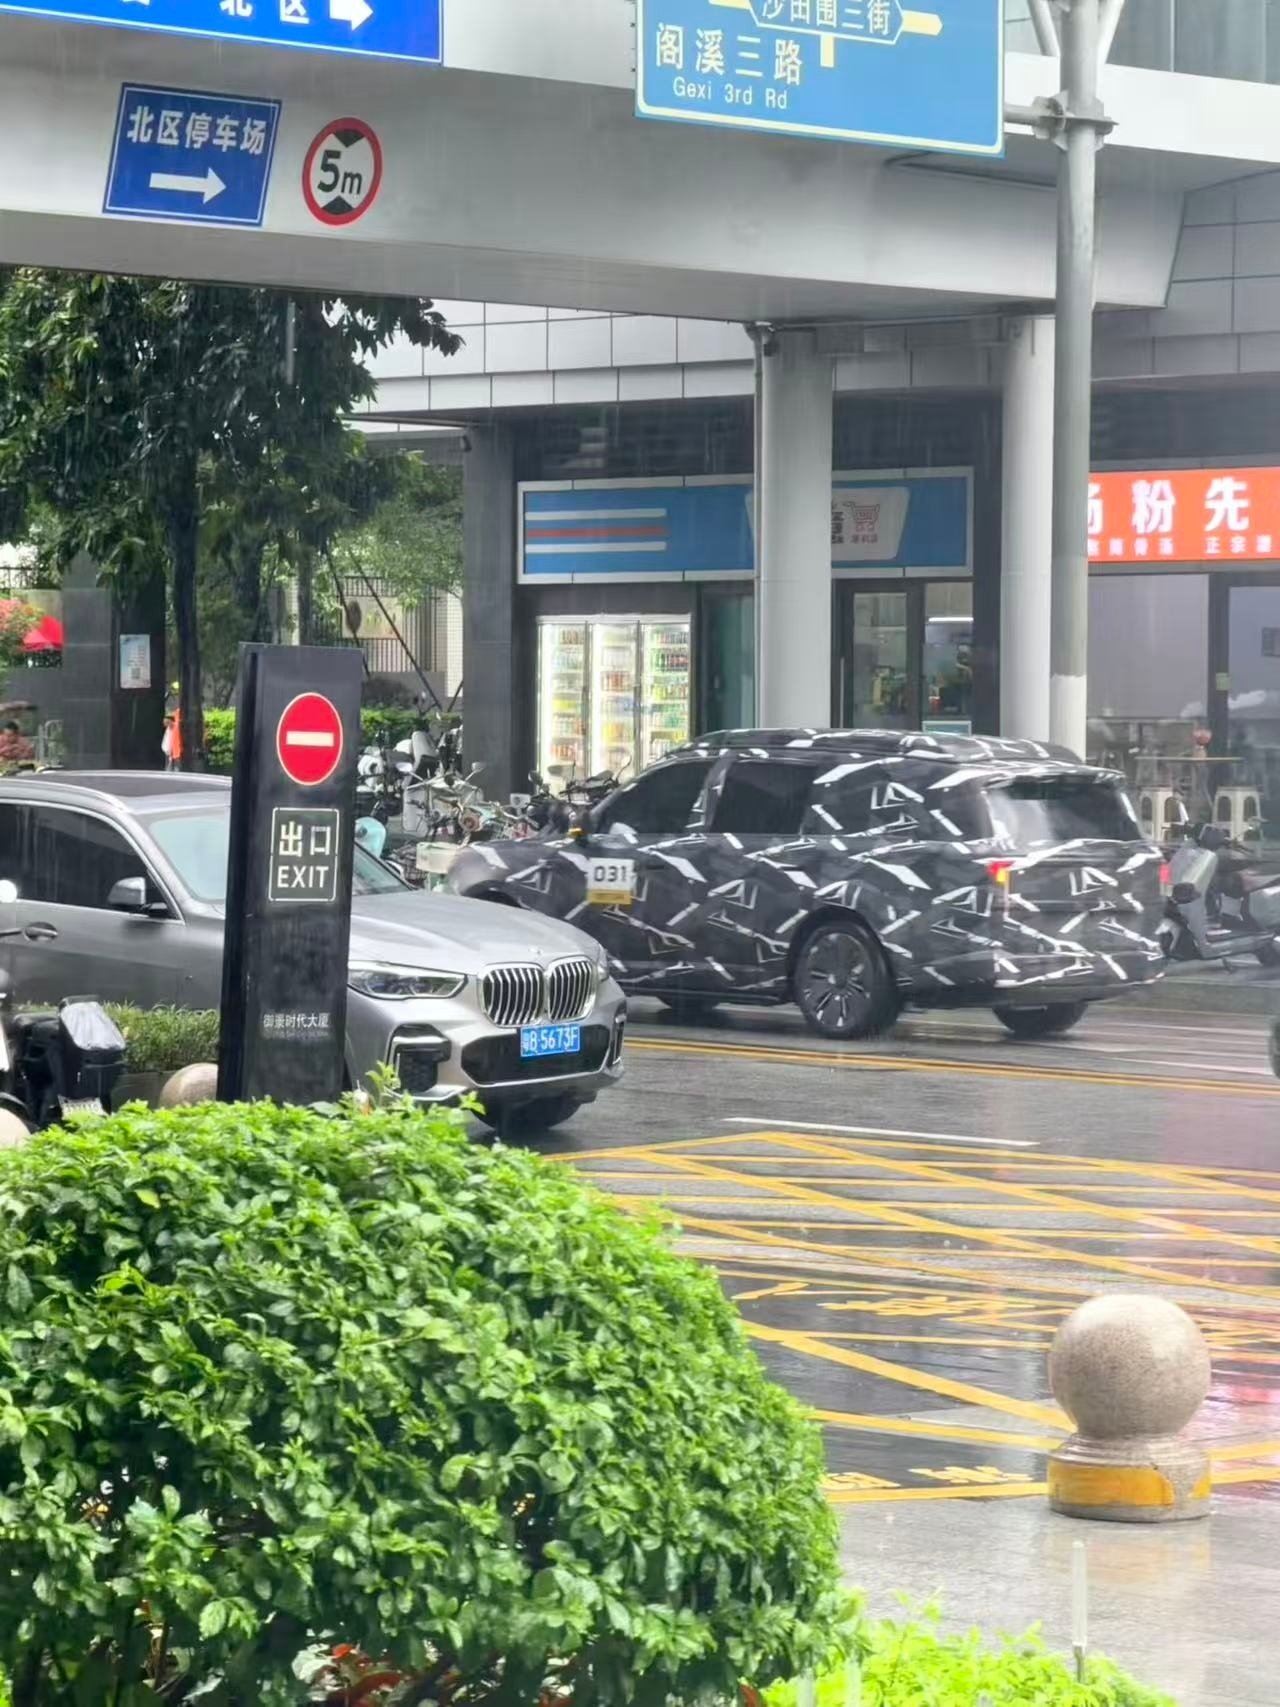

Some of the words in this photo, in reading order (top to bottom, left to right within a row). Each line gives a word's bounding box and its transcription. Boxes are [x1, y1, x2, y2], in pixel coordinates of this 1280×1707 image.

[655, 22, 803, 86] 阁溪三路
[673, 76, 712, 100] Gexi
[724, 83, 753, 105] 3rd
[765, 88, 788, 109] Rd
[127, 105, 267, 155] 北区停车场
[317, 149, 363, 197] 5m
[279, 821, 332, 857] 出口
[277, 865, 330, 889] EXIT
[594, 865, 627, 882] 031
